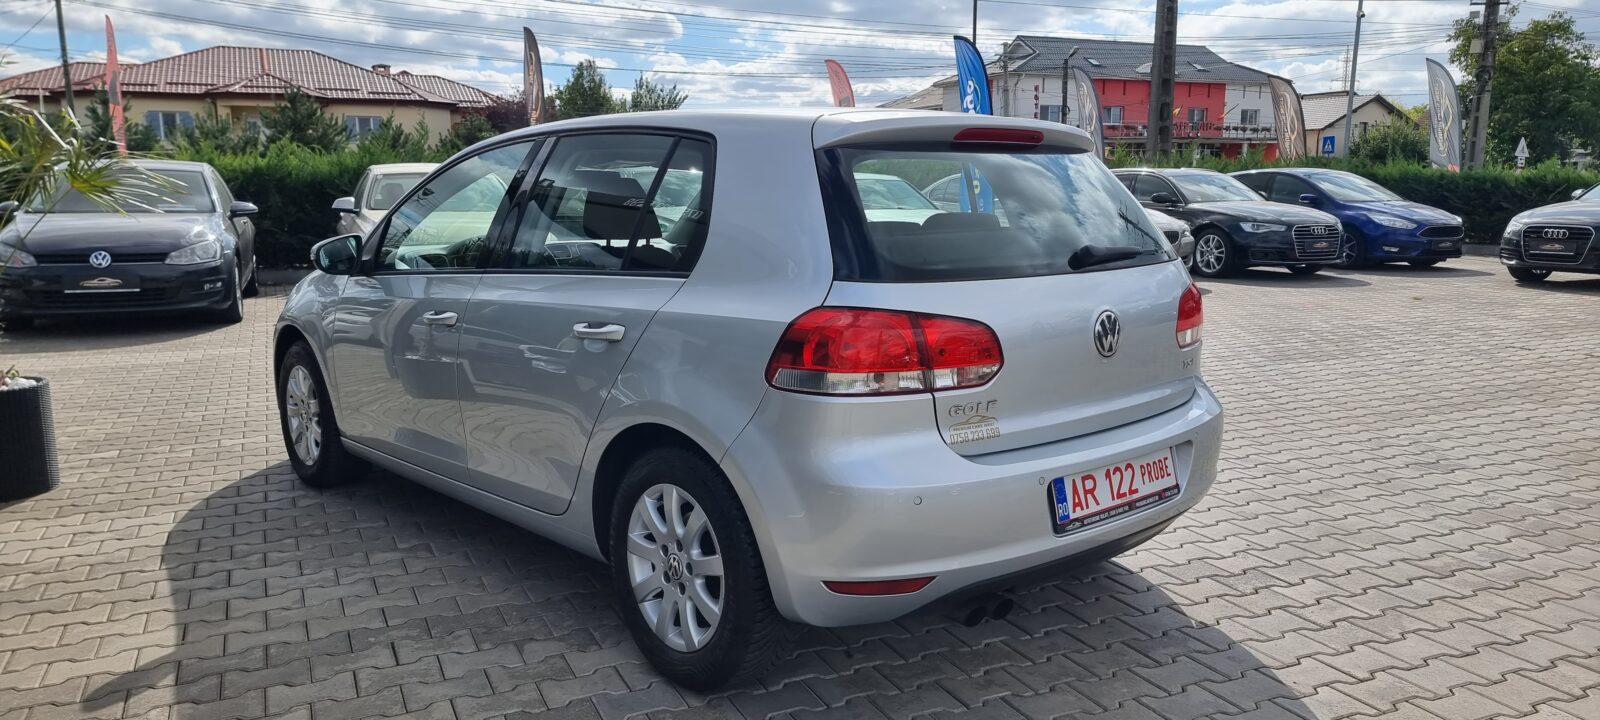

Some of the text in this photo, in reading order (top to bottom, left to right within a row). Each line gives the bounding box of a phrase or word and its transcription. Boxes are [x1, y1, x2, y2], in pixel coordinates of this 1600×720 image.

[949, 399, 998, 417] GOLF
[950, 427, 1000, 445] 0758 233 699
[1057, 502, 1069, 518] RO
[1071, 473, 1100, 514] AR
[1104, 462, 1139, 501] 122
[1139, 456, 1171, 486] PROBE
